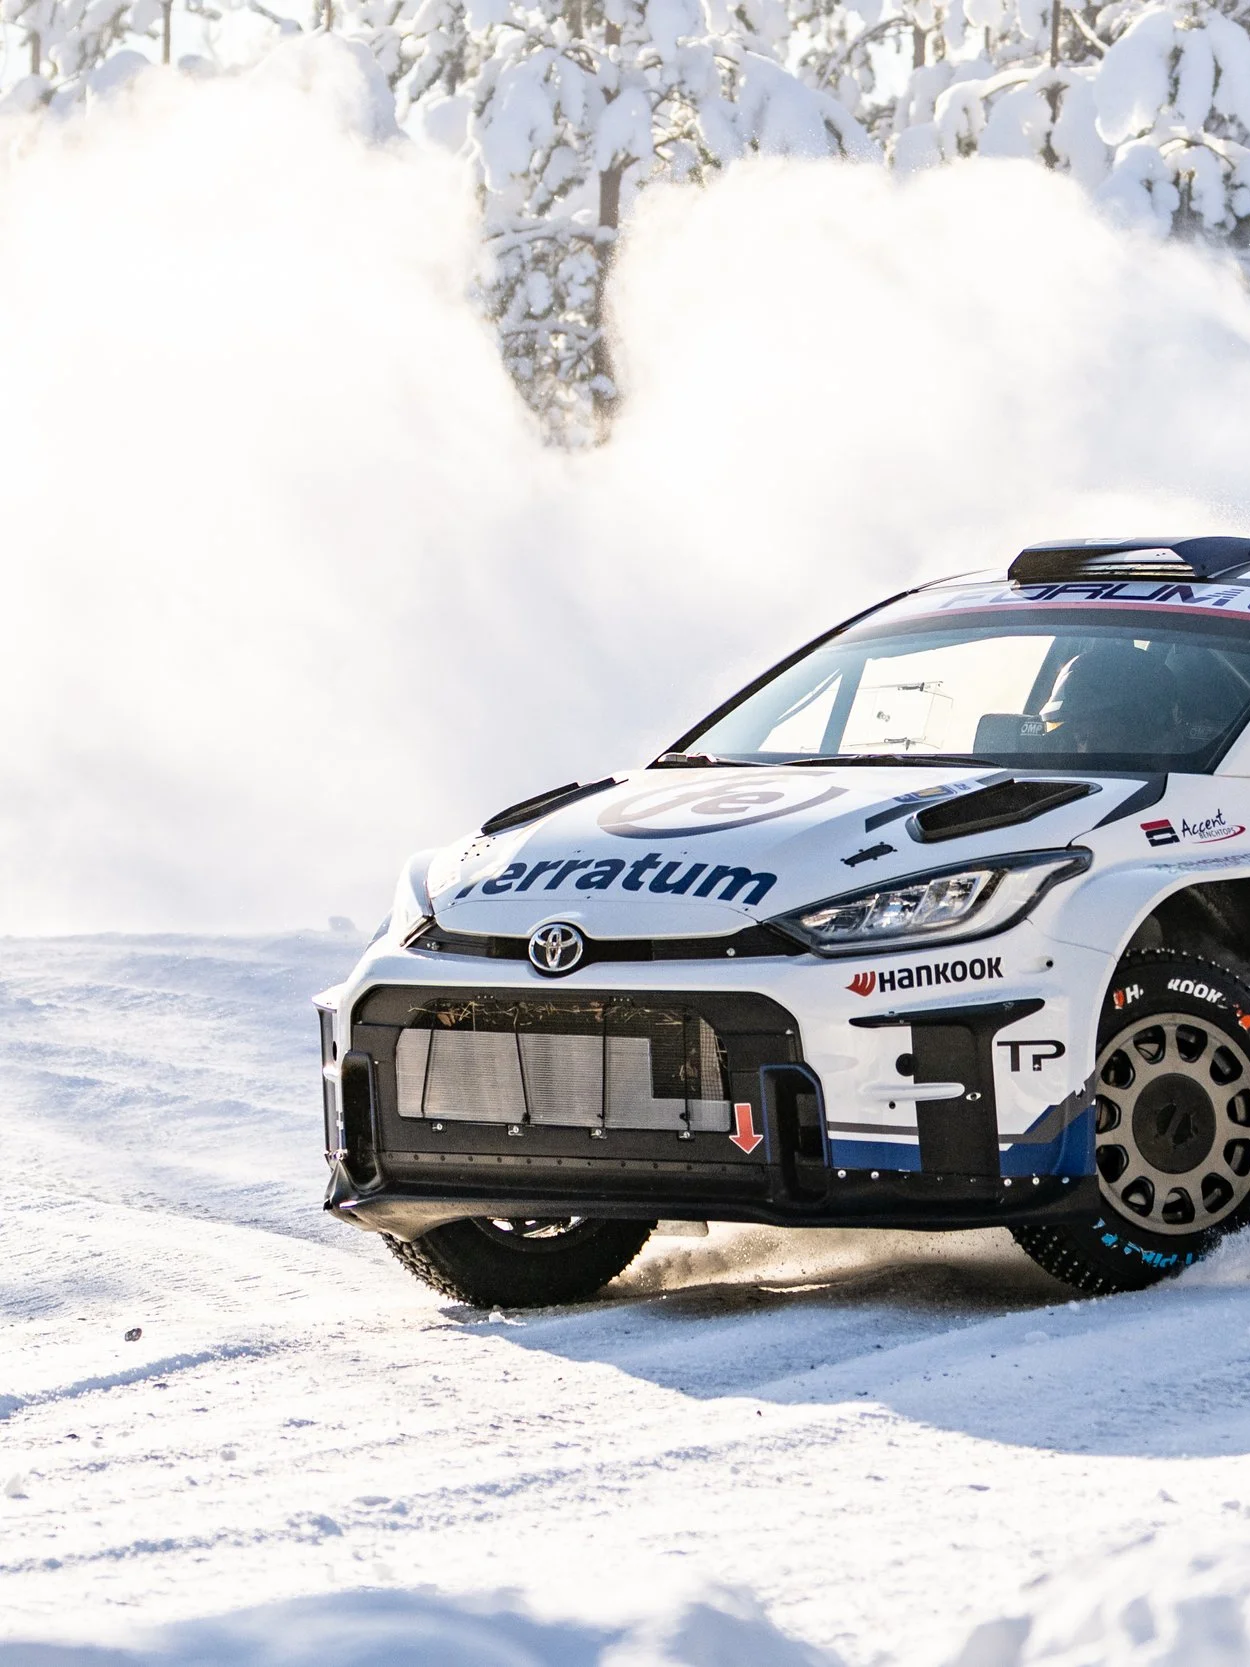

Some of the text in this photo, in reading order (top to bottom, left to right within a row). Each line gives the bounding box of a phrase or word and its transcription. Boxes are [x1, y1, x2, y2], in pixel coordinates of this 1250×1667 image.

[1020, 722, 1043, 734] OMP
[1181, 808, 1226, 838] Accent
[1199, 826, 1236, 840] BENCHTOPS
